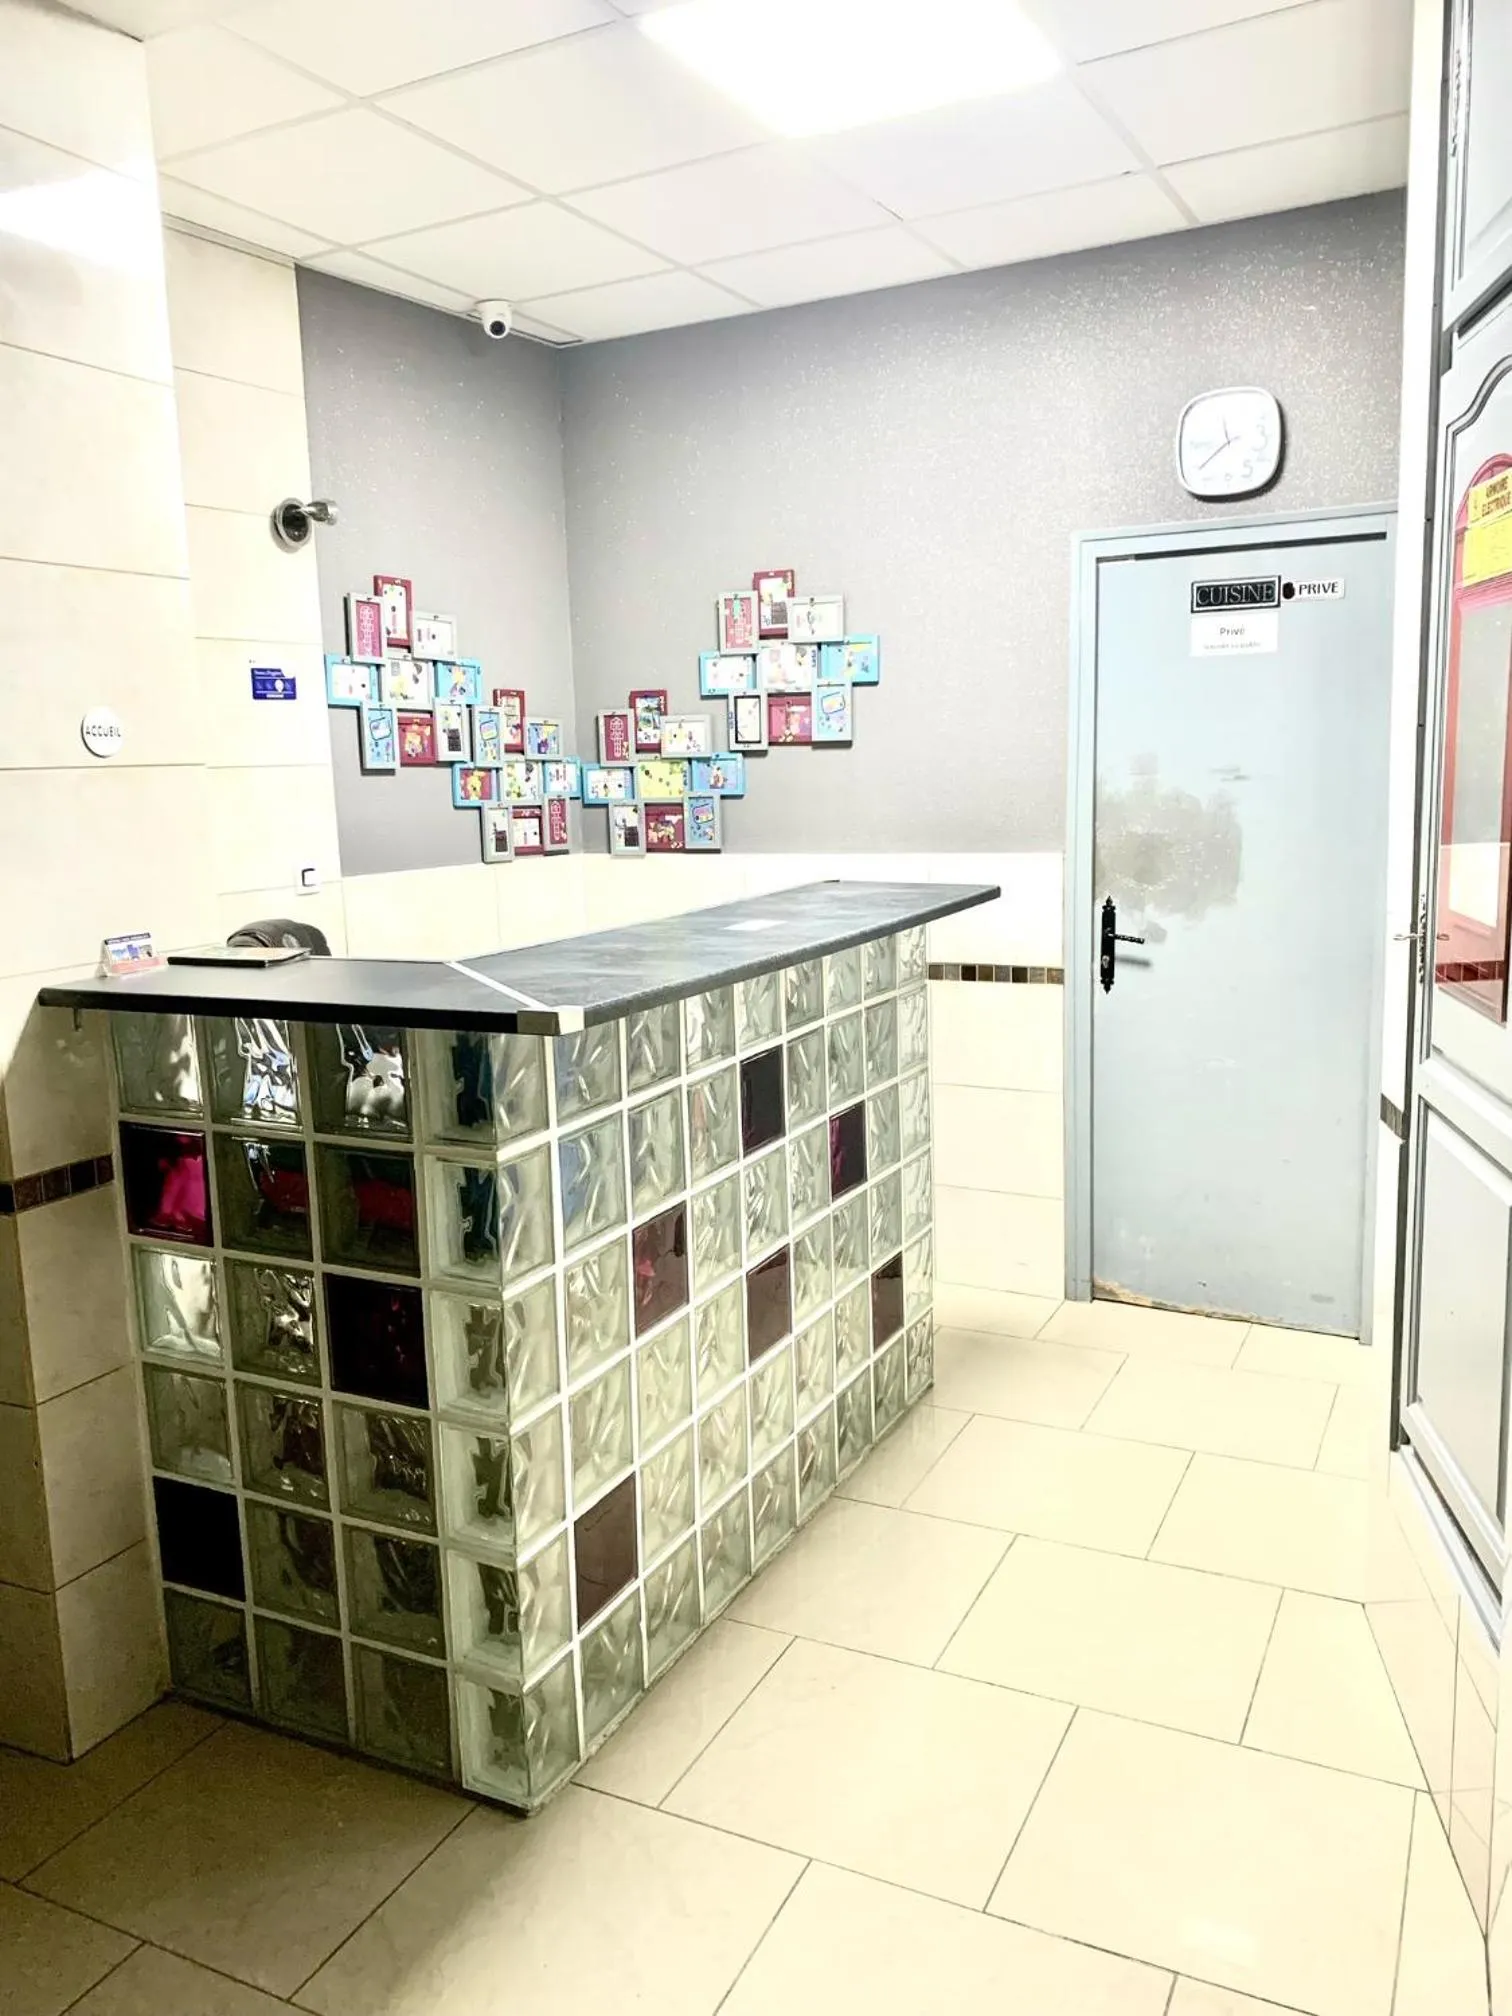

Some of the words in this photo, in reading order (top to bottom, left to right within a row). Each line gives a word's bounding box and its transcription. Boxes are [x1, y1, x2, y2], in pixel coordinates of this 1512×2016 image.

[1196, 583, 1275, 606] CUISINE
[1298, 581, 1339, 596] PRIVE
[85, 725, 121, 738] ACCUEIL
